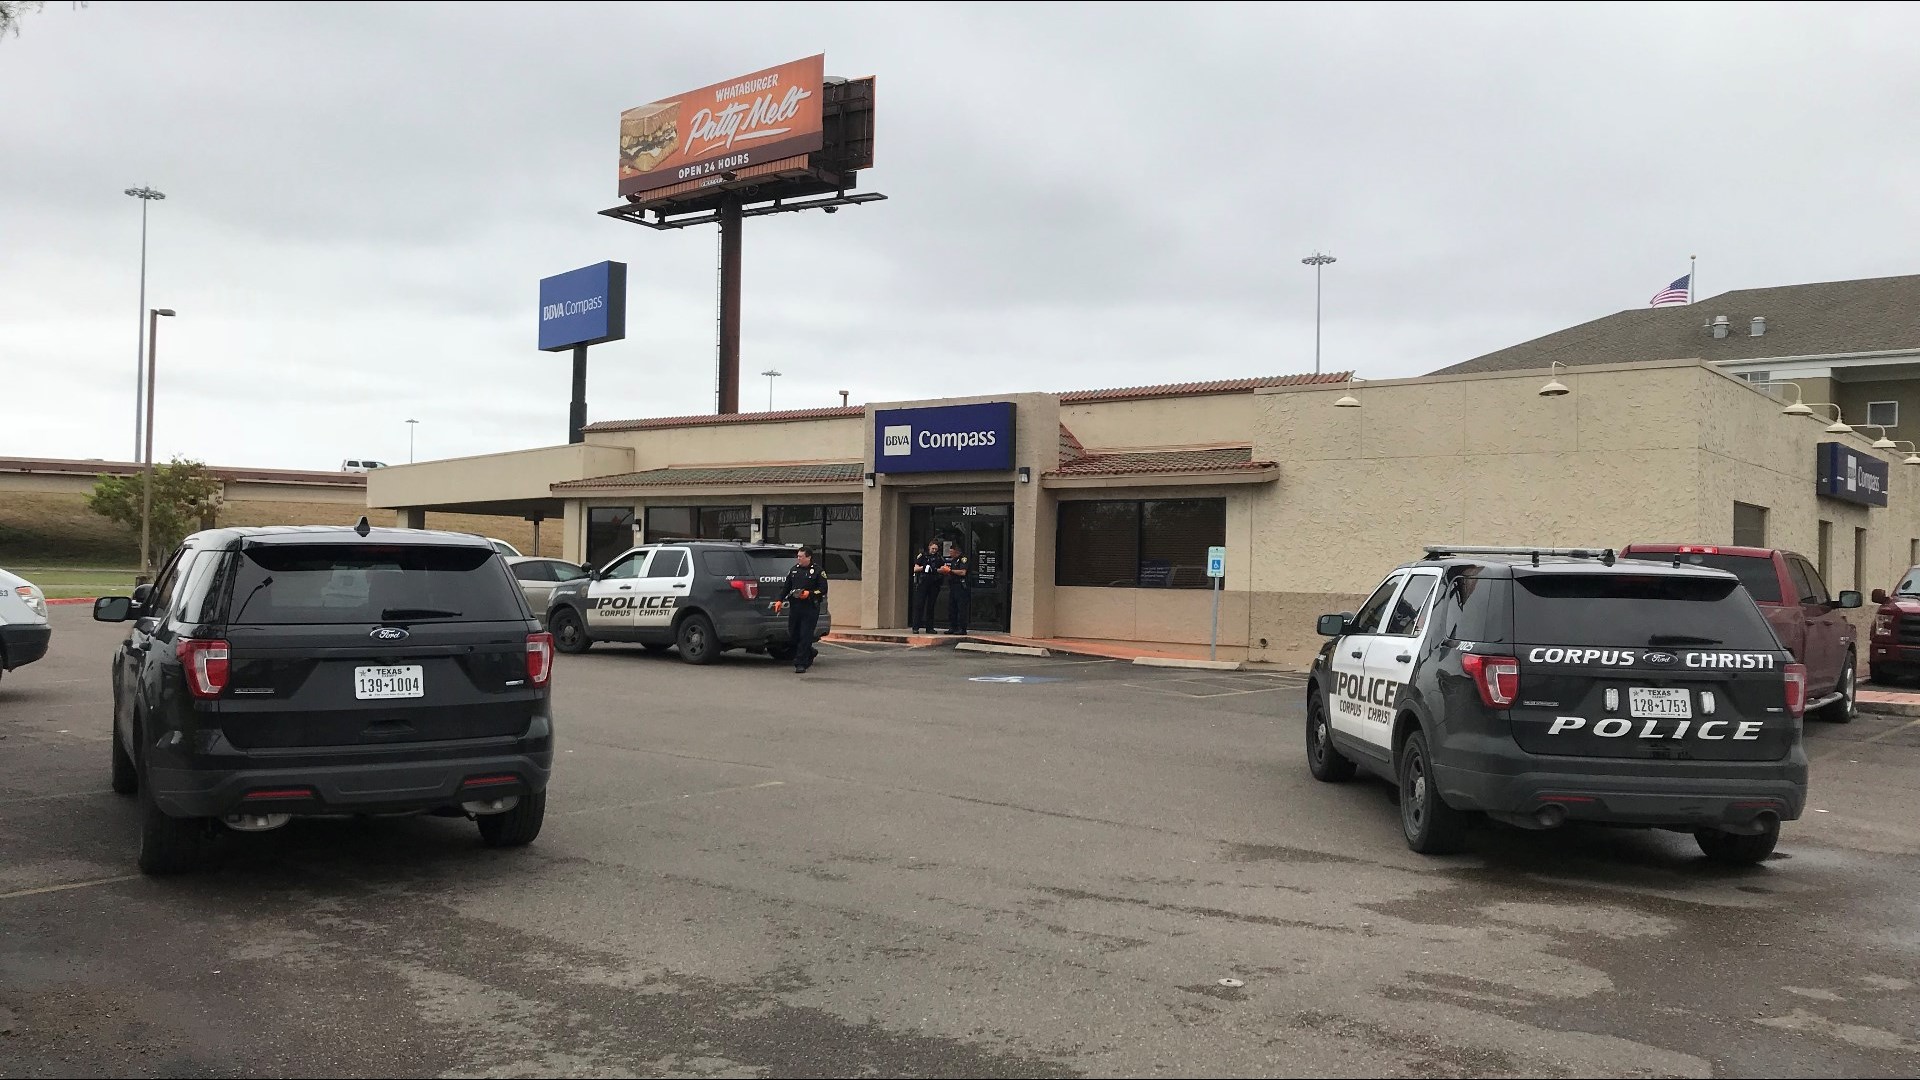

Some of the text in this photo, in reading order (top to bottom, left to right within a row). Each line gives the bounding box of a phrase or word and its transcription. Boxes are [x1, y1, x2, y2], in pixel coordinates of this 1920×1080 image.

[715, 74, 778, 102] WHATABURGER
[684, 85, 812, 154] Patty Melt
[678, 153, 749, 179] OPEN 24 HOURS
[543, 295, 602, 321] BBVA Compass
[885, 430, 996, 451] BBVA Compass
[962, 506, 977, 516] 5015
[597, 596, 675, 609] POLICE
[600, 609, 671, 617] CORPUS CHRISTI
[379, 629, 401, 639] Ford
[1529, 647, 1774, 669] CORPUS CHRISTI
[1651, 654, 1671, 663] Ford
[1338, 672, 1397, 707] POLICE
[1647, 689, 1671, 697] TEXAS
[1339, 699, 1362, 717] CORPUS
[1547, 716, 1764, 740] POLICE
